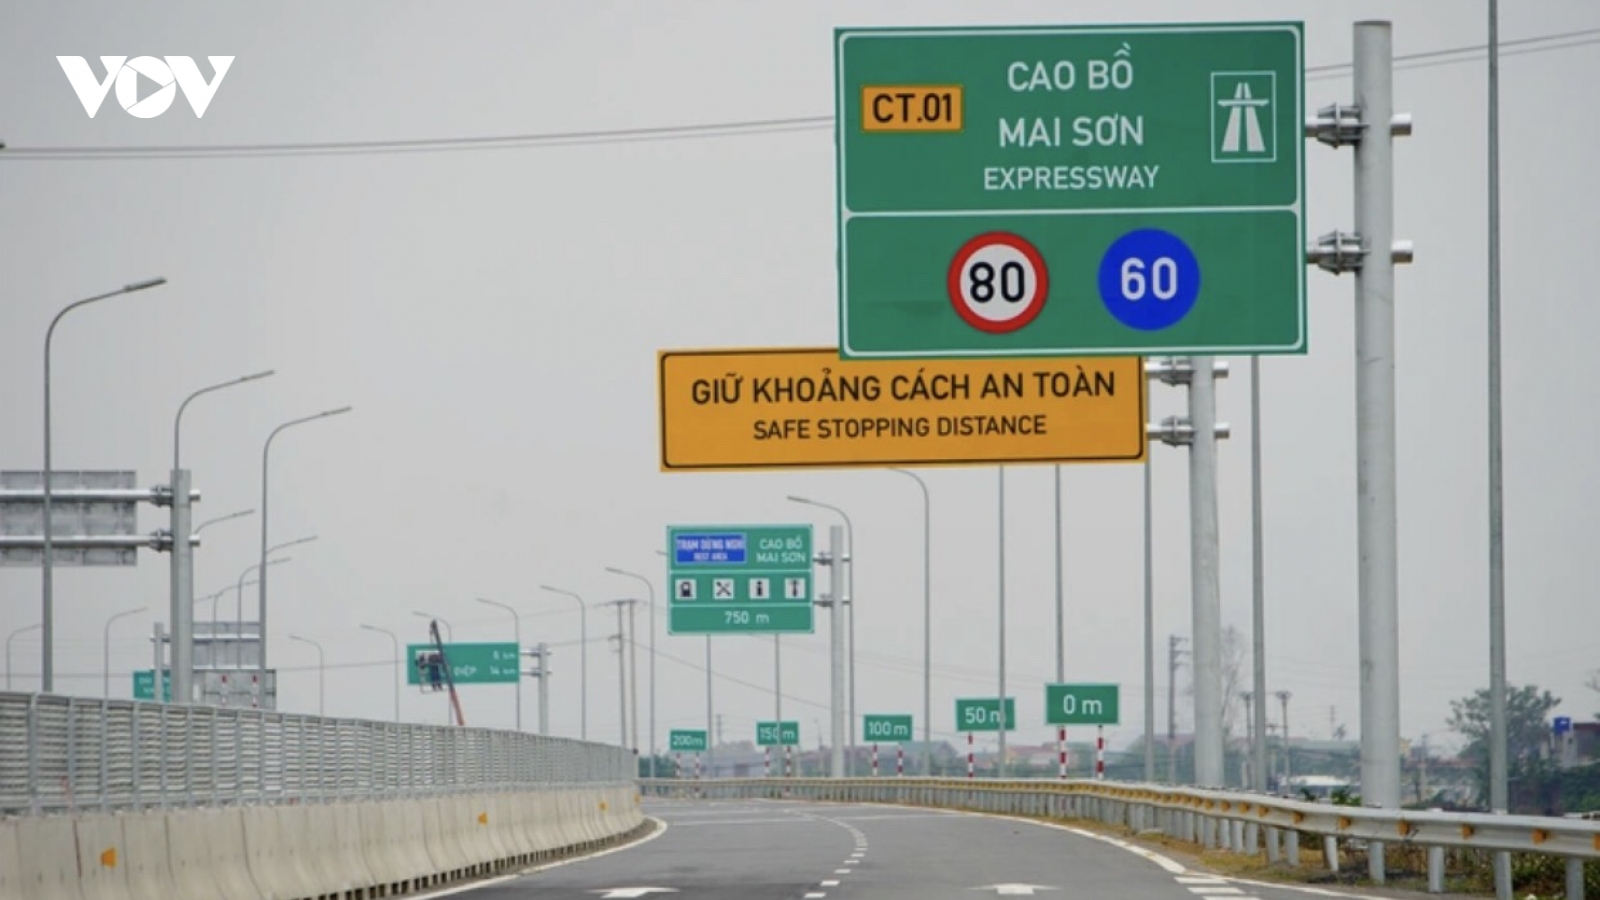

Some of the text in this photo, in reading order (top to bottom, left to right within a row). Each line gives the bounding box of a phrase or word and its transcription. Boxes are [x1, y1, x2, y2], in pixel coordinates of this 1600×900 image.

[1007, 42, 1133, 92] CAO BỒ
[872, 92, 954, 124] CT.01
[998, 113, 1144, 147] MAI SƠN
[983, 165, 1159, 190] EXPRESSWAY
[969, 261, 1026, 304] 80
[1120, 256, 1178, 300] 60
[691, 365, 1116, 405] GIỮ KHOẢNG CÁCH AN TOÀN
[753, 414, 1047, 440] SAFE STOPPING DISTANCE
[759, 538, 784, 550] CAO
[756, 552, 778, 563] MAI
[724, 610, 770, 624] 750 m
[965, 706, 987, 724] 50
[1063, 694, 1103, 715] 0 m
[759, 726, 796, 739] 150 m
[867, 721, 909, 737] 100 m
